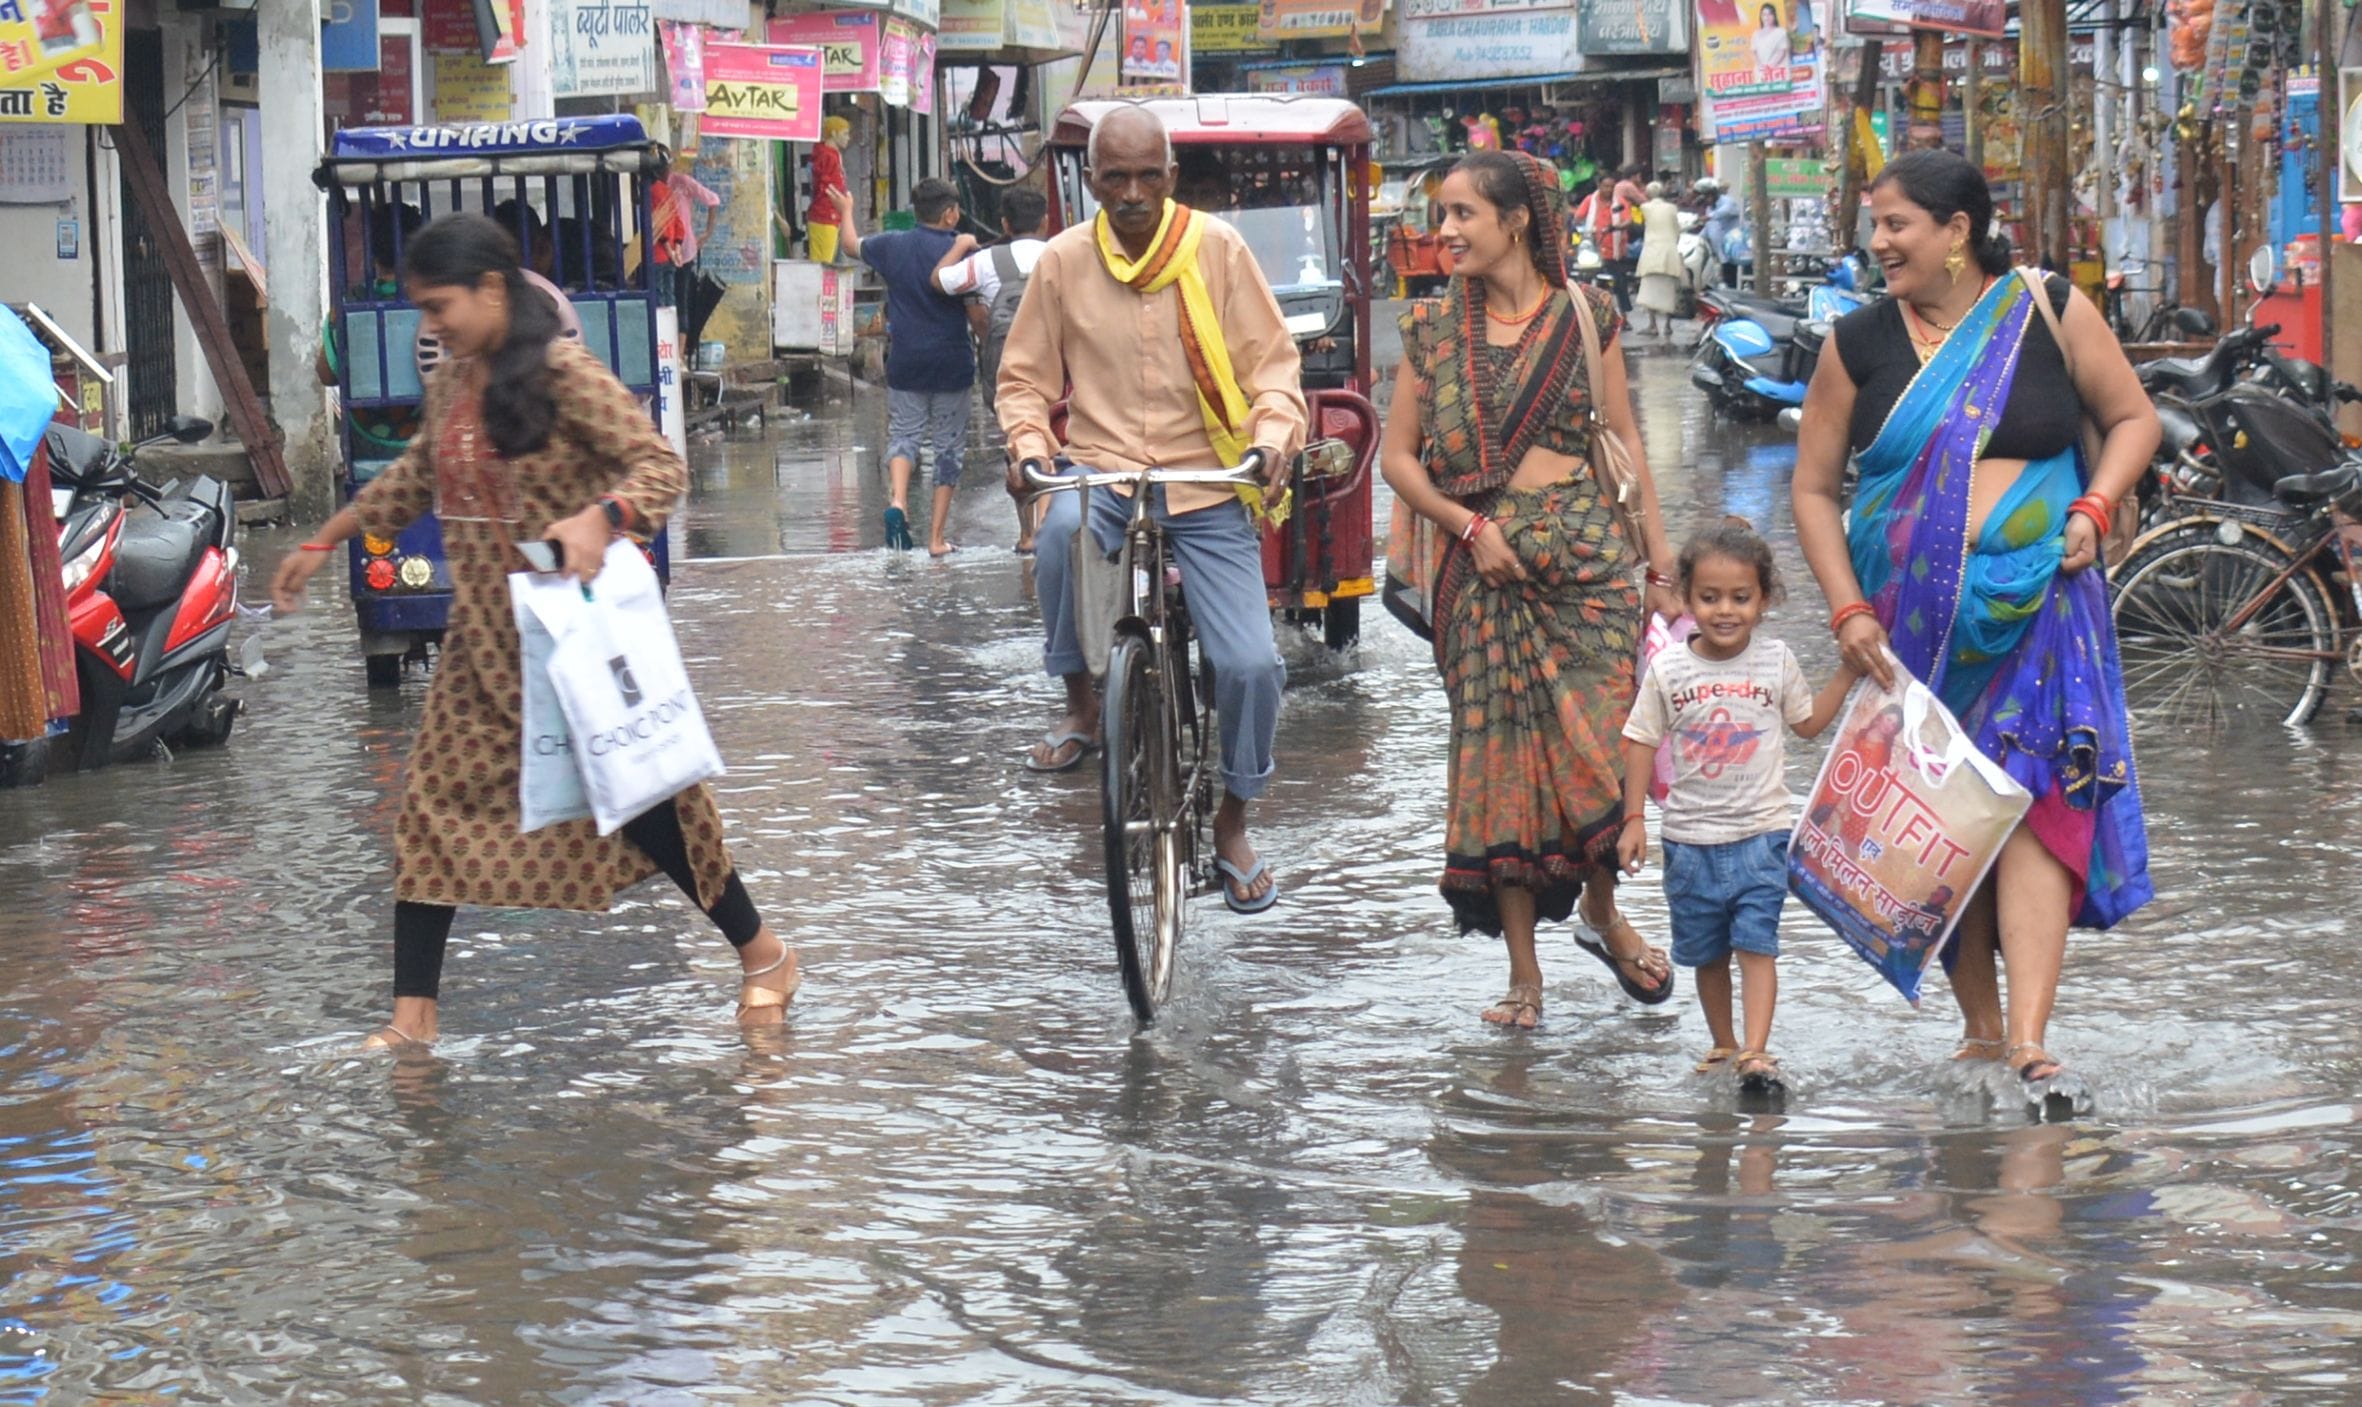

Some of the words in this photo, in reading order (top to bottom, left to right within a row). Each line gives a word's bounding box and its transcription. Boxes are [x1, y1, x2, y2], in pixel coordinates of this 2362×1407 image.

[822, 46, 863, 65] TAR
[40, 82, 68, 115] है
[409, 121, 558, 148] UMANG
[1828, 750, 1971, 879] OUTFIT
[1859, 835, 1884, 862] एवं
[1821, 835, 1876, 899] मिलन
